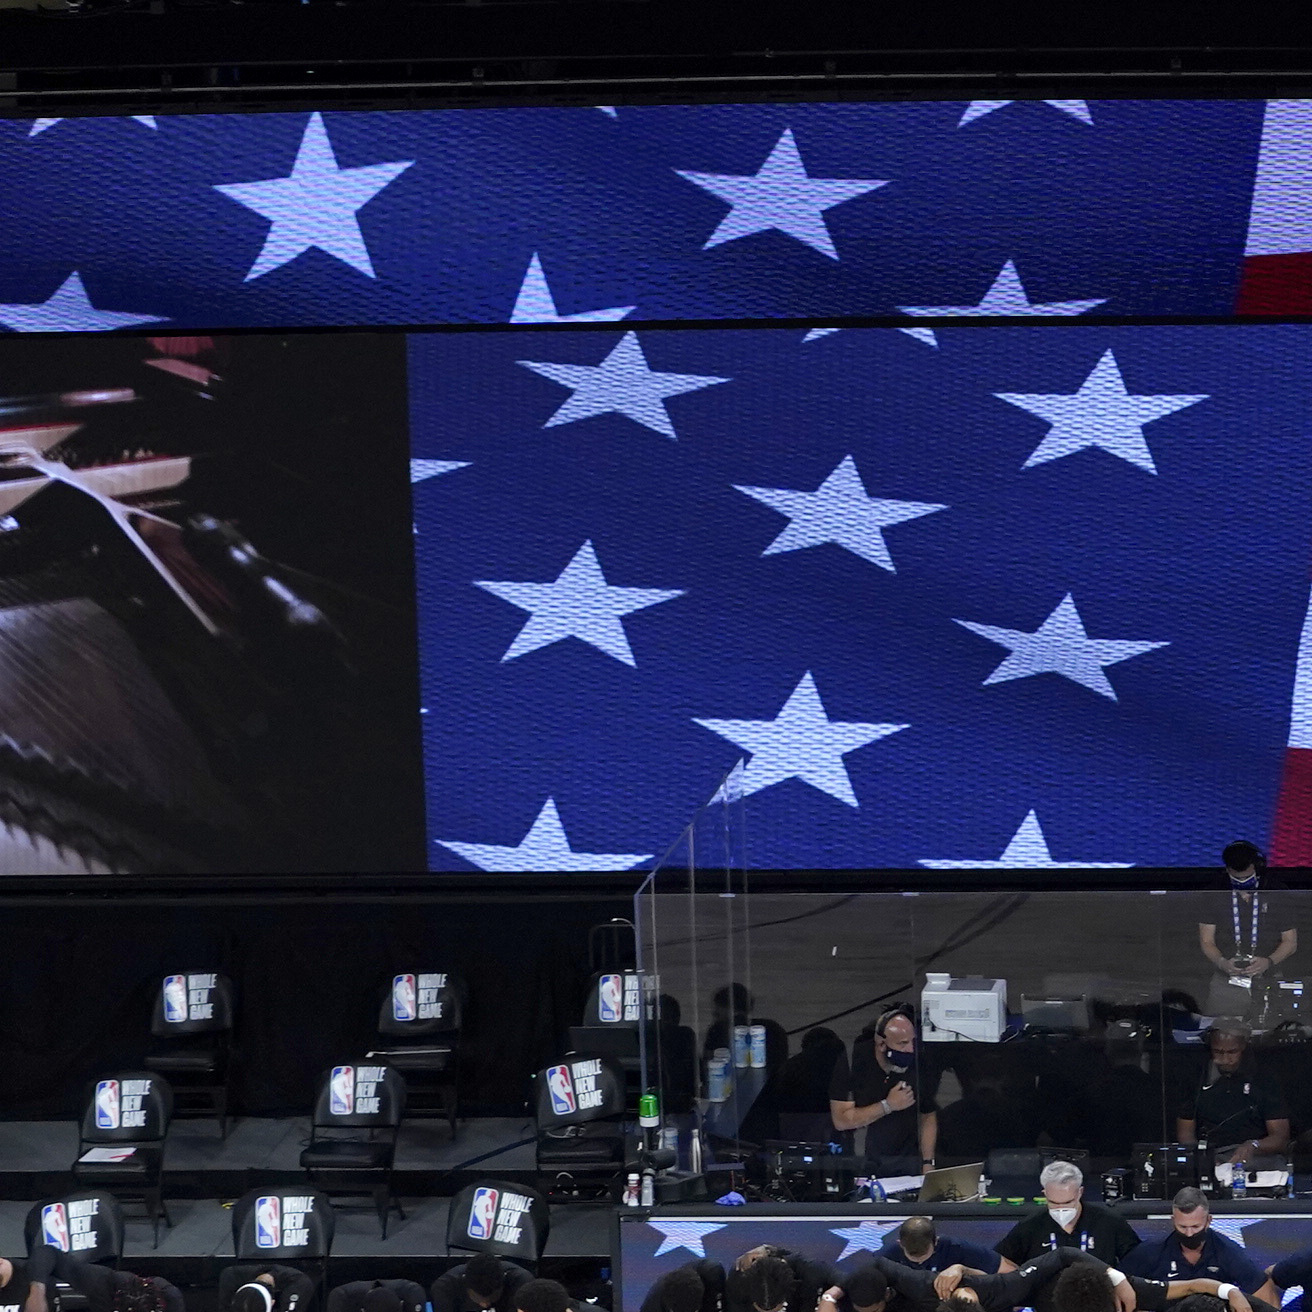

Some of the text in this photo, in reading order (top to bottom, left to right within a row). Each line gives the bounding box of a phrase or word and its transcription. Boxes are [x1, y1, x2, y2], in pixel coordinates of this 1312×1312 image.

[418, 974, 447, 989] WHOLE
[418, 1003, 443, 1019] GAME
[356, 1067, 387, 1083] WHOLE
[571, 1059, 602, 1079] WHOLE
[122, 1080, 152, 1096] WHOLE
[356, 1082, 377, 1098] NEW
[574, 1075, 596, 1095] NEW
[122, 1095, 142, 1111] NEW
[356, 1097, 380, 1113] GAME
[578, 1090, 603, 1110] GAME
[122, 1110, 146, 1127] GAME
[68, 1199, 100, 1218] WHOLE
[283, 1196, 315, 1213] WHOLE
[500, 1192, 534, 1213] WHOLE
[69, 1215, 91, 1234] NEW
[283, 1212, 304, 1230] NEW
[497, 1208, 521, 1226] NEW
[71, 1230, 98, 1251] GAME
[283, 1228, 310, 1246] GAME
[494, 1224, 522, 1245] GAME
